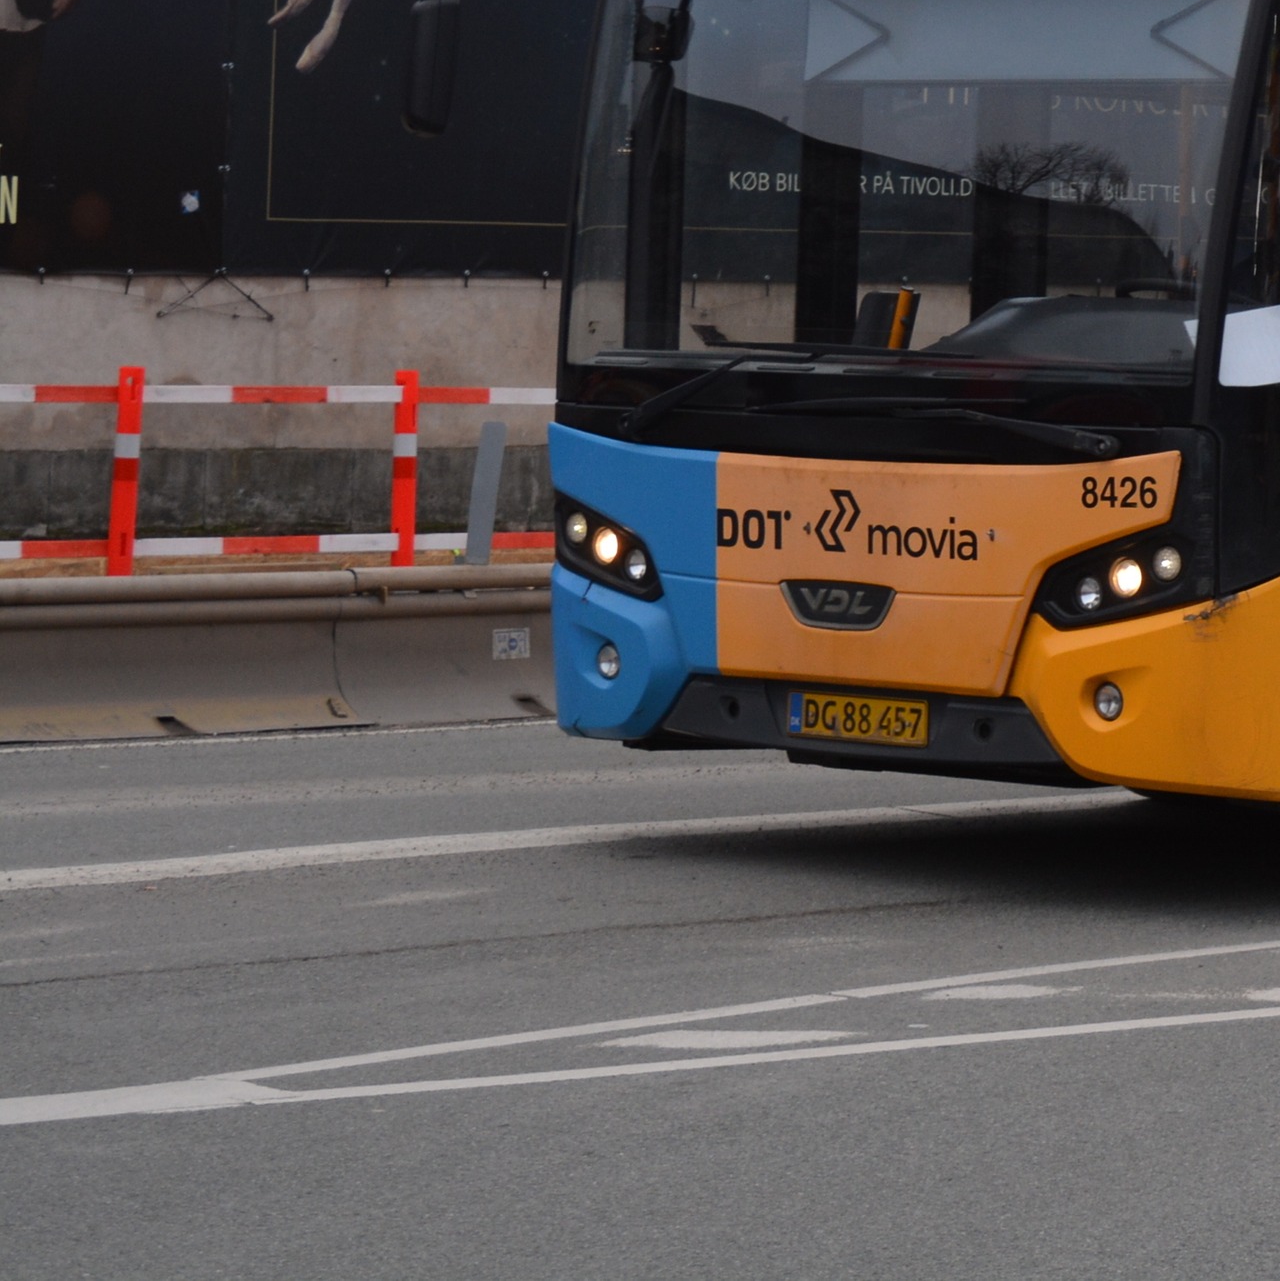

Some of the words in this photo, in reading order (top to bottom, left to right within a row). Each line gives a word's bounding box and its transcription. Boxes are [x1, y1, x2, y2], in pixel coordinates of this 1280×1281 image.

[729, 172, 770, 191] KØB
[873, 171, 895, 194] PÅ
[1081, 476, 1158, 508] 8426
[716, 508, 791, 549] DOT
[867, 516, 978, 561] movia
[800, 588, 873, 614] VDL
[805, 699, 837, 730] DG
[843, 702, 871, 734] 88
[878, 706, 923, 738] 457
